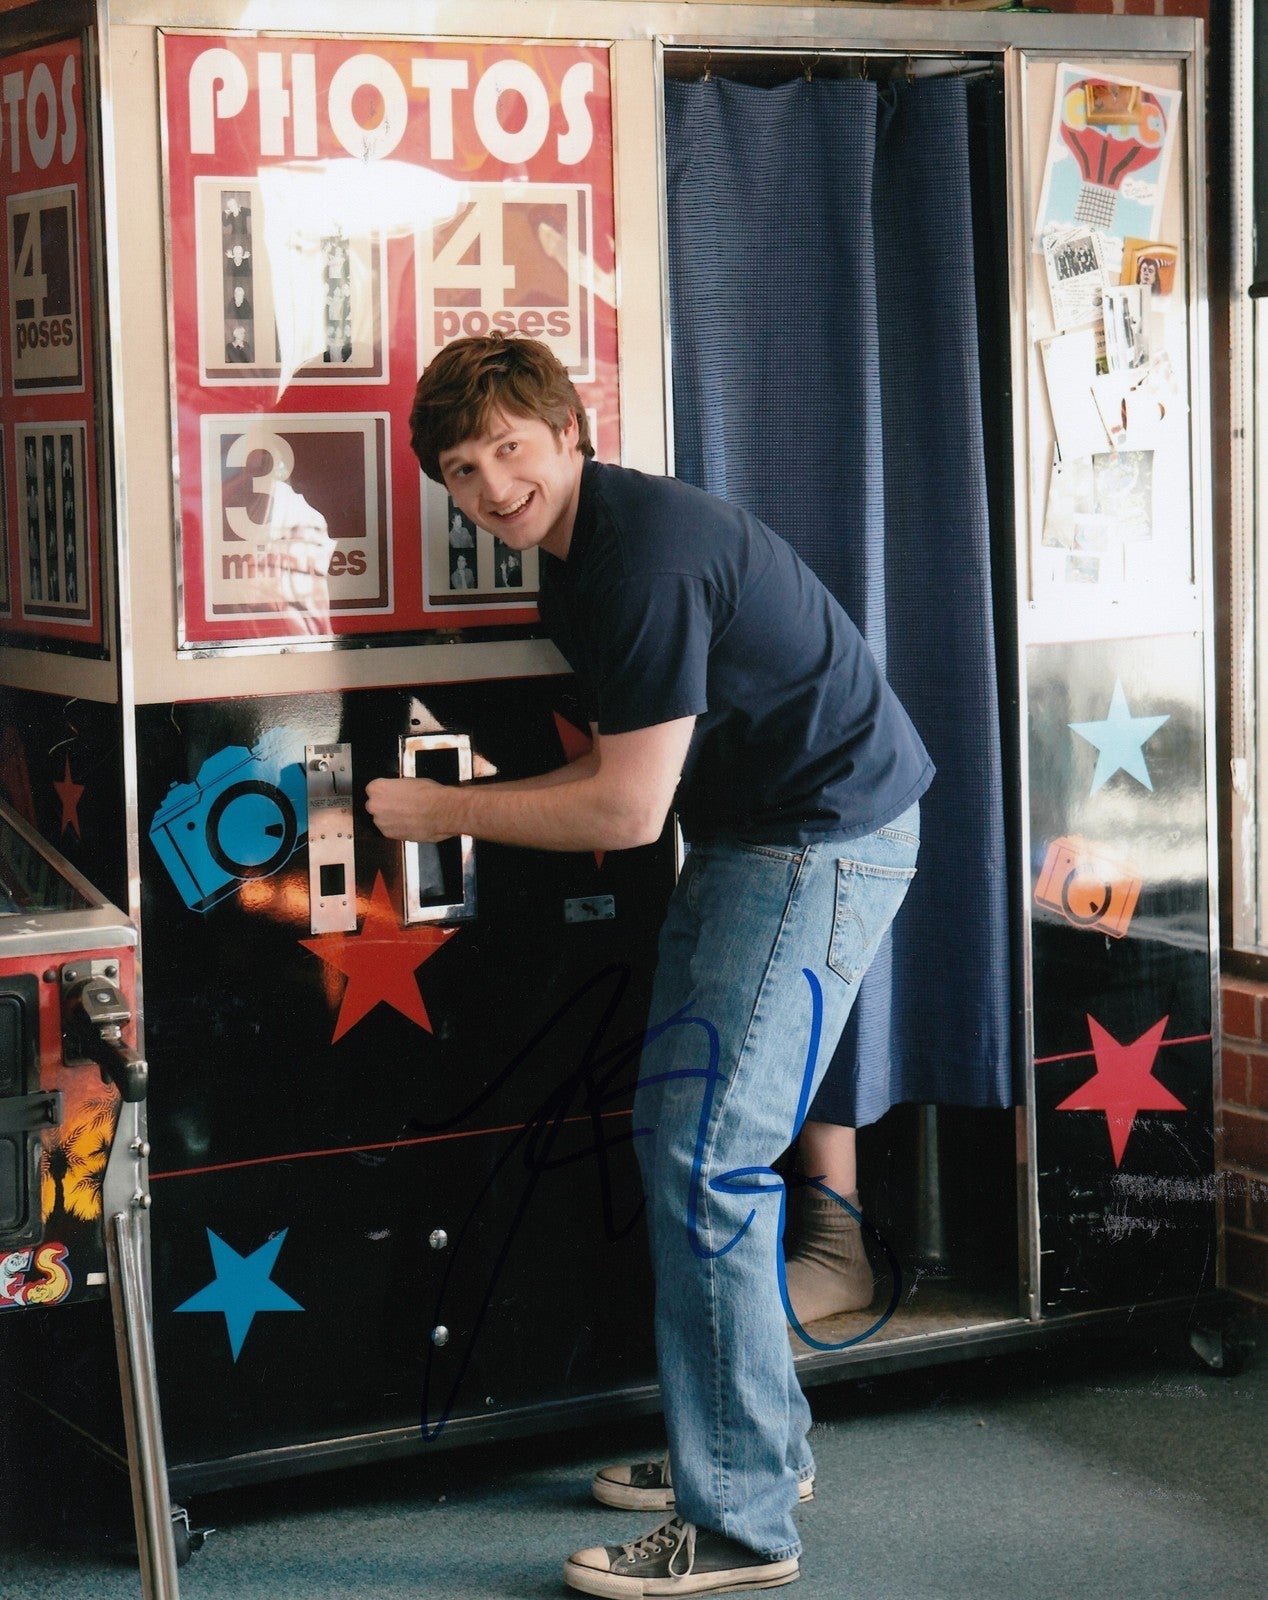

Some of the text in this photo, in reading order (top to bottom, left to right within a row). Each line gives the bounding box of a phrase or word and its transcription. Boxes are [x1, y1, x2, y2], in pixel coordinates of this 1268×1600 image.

[0, 54, 77, 173] TOS
[188, 47, 594, 165] PHOTOS
[15, 210, 48, 318] 4
[432, 200, 516, 308] 4
[16, 318, 74, 359] poses
[434, 310, 571, 346] poses
[225, 432, 295, 542] 3
